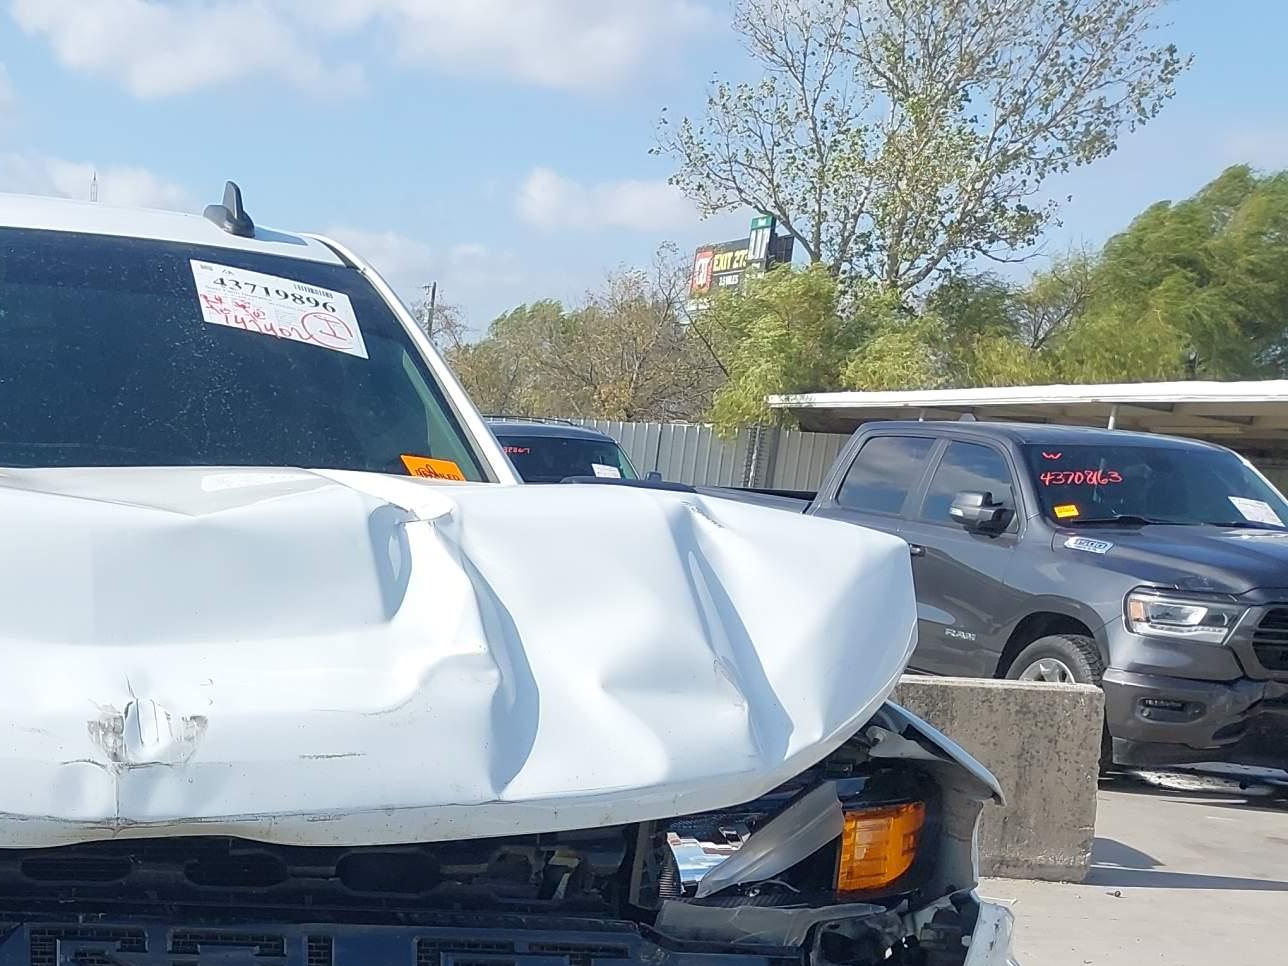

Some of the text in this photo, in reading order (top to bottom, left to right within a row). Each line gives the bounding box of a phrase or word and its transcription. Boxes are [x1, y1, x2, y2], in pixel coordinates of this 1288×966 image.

[714, 252, 733, 271] EXIT
[213, 277, 336, 313] 43719896
[944, 628, 977, 641] RAM
